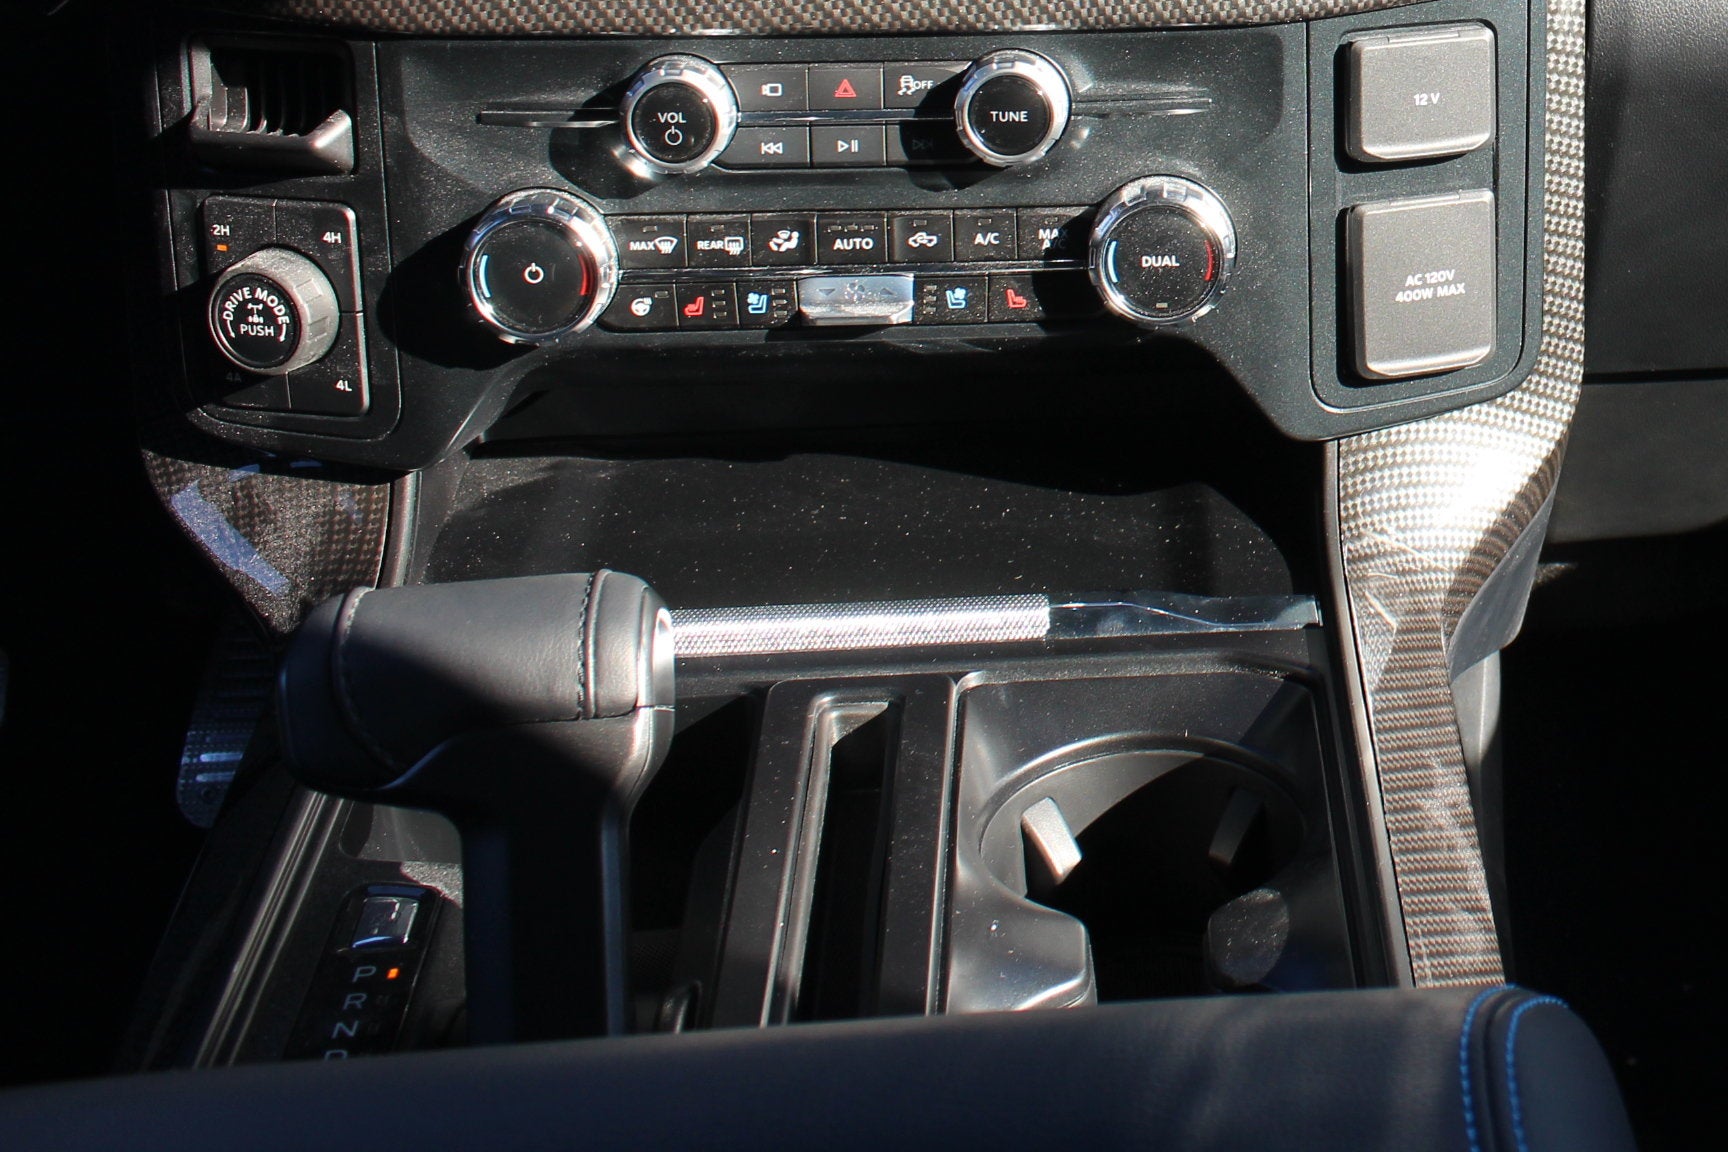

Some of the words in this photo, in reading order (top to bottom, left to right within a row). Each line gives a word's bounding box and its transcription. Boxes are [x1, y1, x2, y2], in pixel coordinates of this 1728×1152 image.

[913, 80, 934, 90] OFF
[1413, 93, 1429, 106] 12
[1430, 93, 1440, 105] V
[657, 110, 687, 125] VOL
[990, 110, 1029, 123] TUNE
[212, 223, 231, 236] 2H
[322, 231, 342, 244] 4H
[833, 237, 874, 250] AUTO
[974, 232, 1000, 245] A/C
[629, 240, 656, 251] MAX
[697, 240, 724, 250] REAR
[1141, 254, 1180, 269] DUAL
[1404, 273, 1423, 288] AC
[1425, 269, 1456, 285] 120V
[1395, 287, 1434, 303] 400W
[1437, 282, 1466, 298] MAX
[222, 286, 253, 321] DRIVE
[254, 287, 290, 325] MODE
[240, 324, 275, 337] PUSH
[335, 379, 353, 392] 4L
[352, 965, 377, 983] P
[342, 992, 368, 1010] R
[331, 1019, 359, 1039] N
